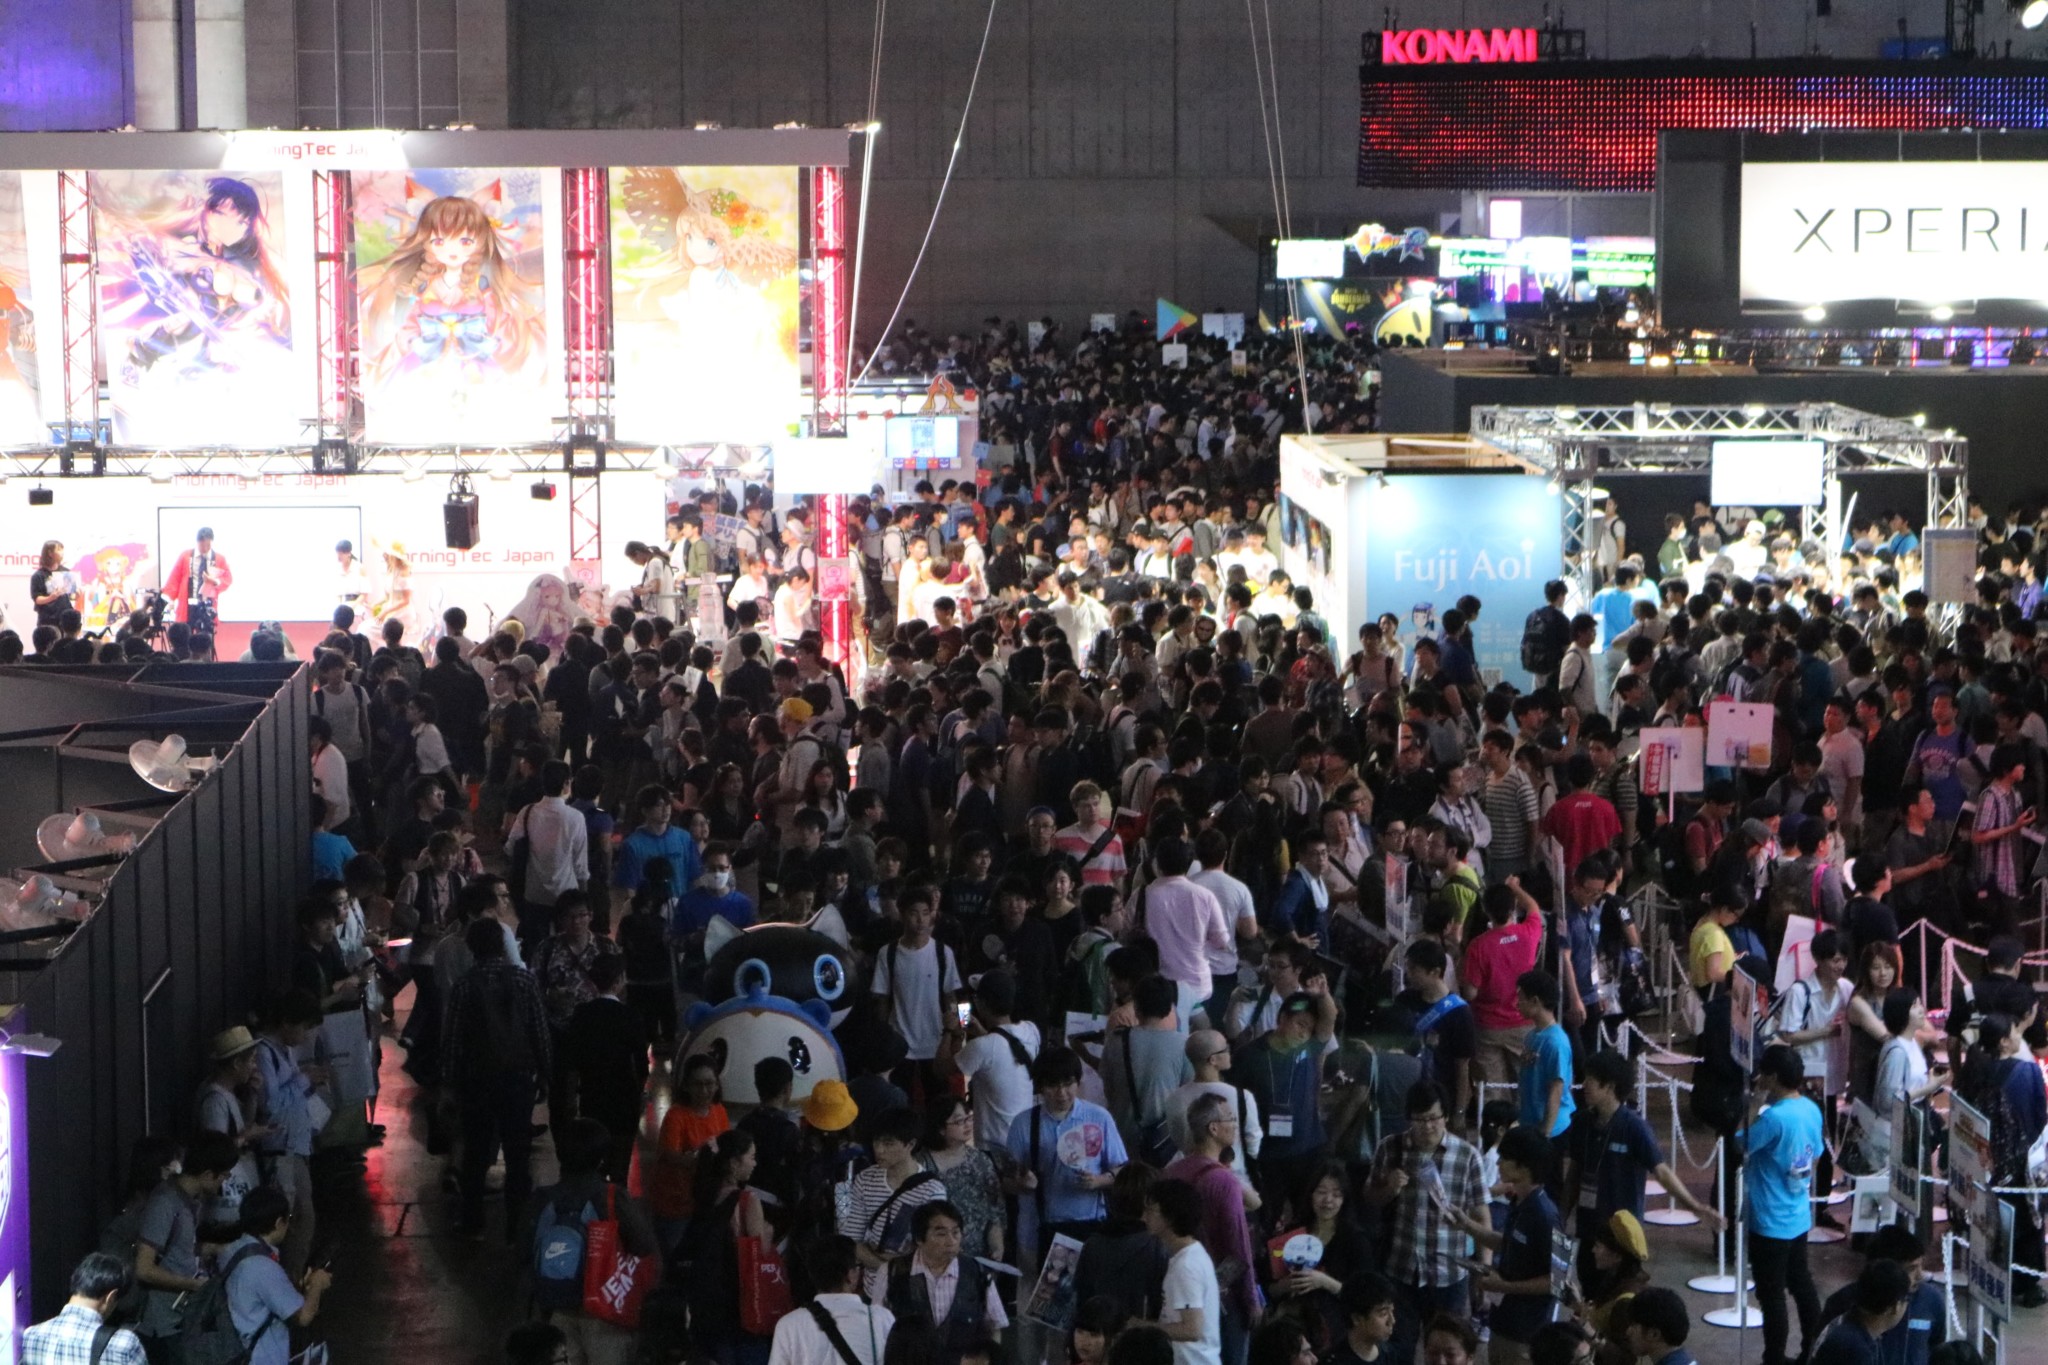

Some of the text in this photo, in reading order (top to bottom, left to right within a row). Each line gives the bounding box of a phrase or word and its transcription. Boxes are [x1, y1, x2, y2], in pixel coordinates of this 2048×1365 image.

[1381, 28, 1538, 64] KONAMI
[1793, 207, 2048, 253] XPERI
[503, 549, 555, 566] Japan
[1394, 539, 1535, 592] Fuji Aoi
